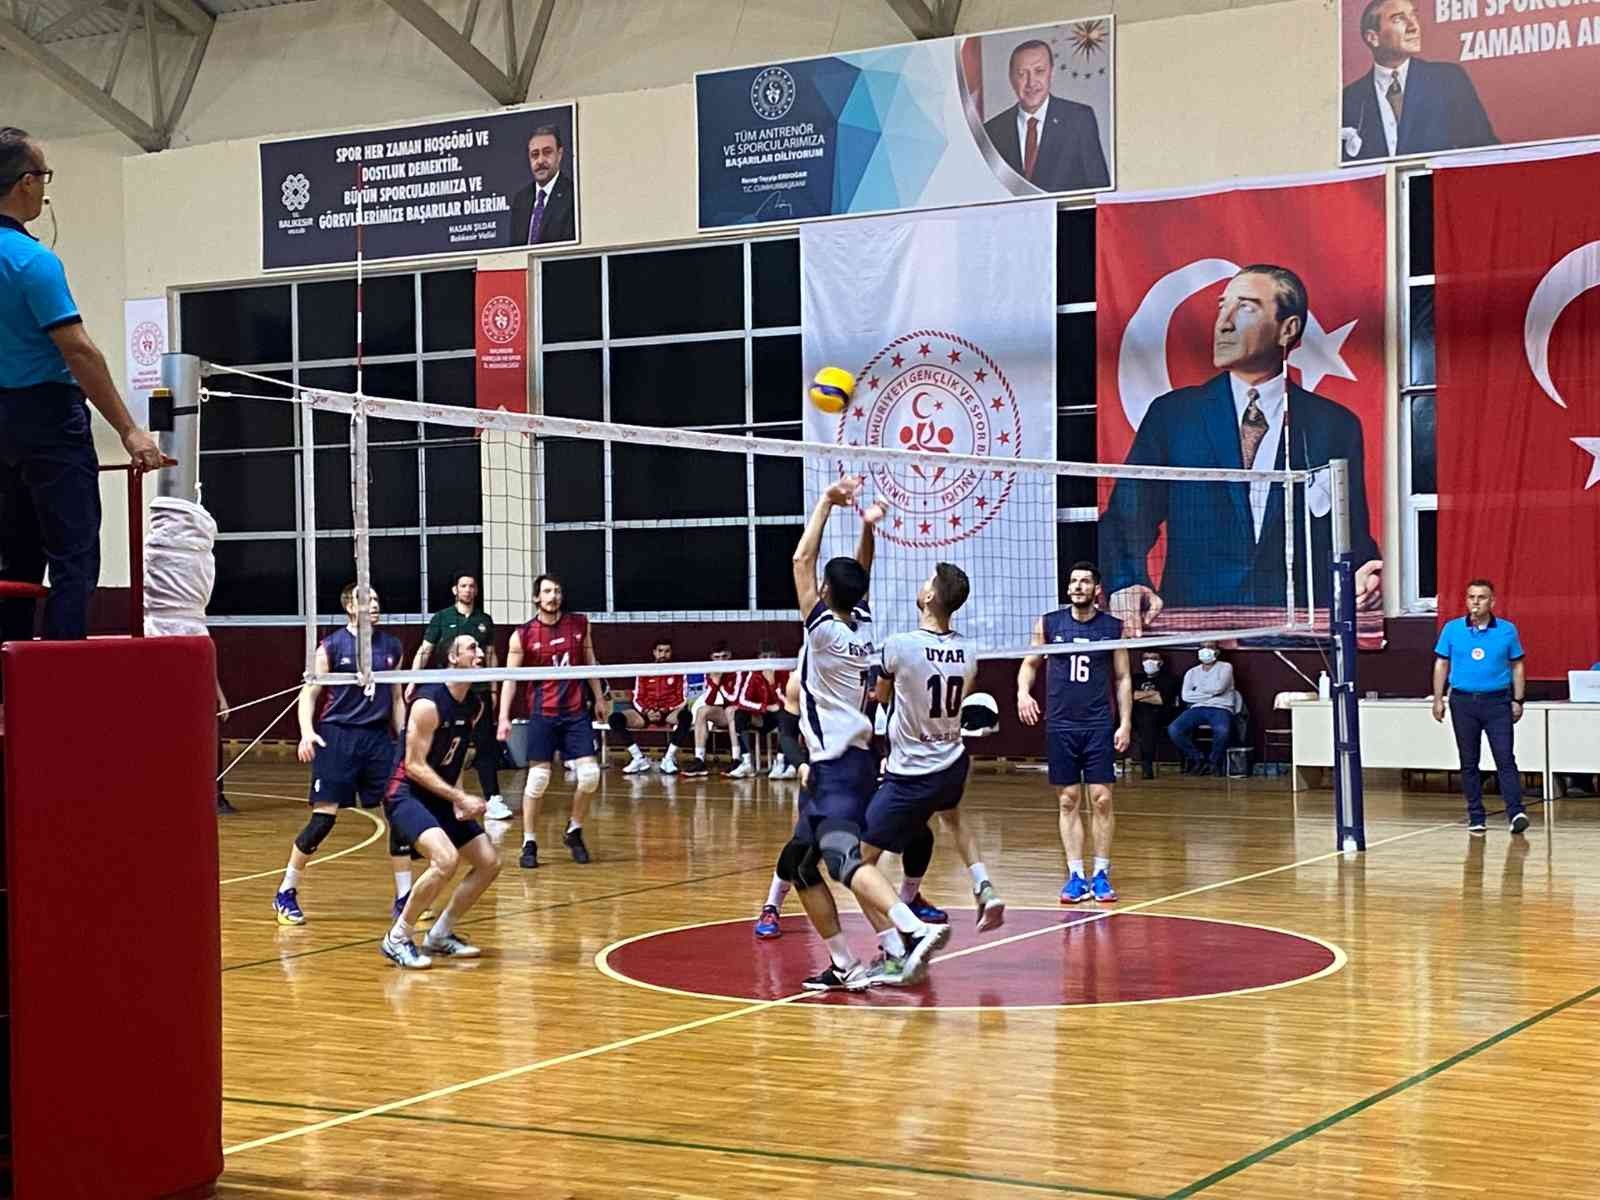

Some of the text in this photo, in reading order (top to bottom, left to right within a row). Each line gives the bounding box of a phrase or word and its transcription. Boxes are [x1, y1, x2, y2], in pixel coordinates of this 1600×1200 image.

[1459, 20, 1571, 62] ZAMANDA
[335, 128, 489, 163] SPOR HER ZAMAN HOŞGÖRÜ VE
[723, 134, 825, 156] VE SPORCULARIMIZA
[734, 123, 814, 143] TÜM ANTRENÖR
[362, 153, 463, 182] DOSTLUK DEMEKTİR.
[725, 147, 824, 168] BAŞARILAR DİLİYORUM
[344, 176, 482, 205] BÜTÜN SPORCULARIMIZA VE
[406, 200, 461, 224] BAŞARILAR
[463, 193, 511, 215] DİLERİM.
[909, 369, 959, 391] GENÇLİK
[960, 386, 974, 405] VE
[970, 404, 986, 441] SPOR
[925, 647, 965, 663] UYAR
[1070, 654, 1090, 682] 16
[927, 674, 964, 718] 10
